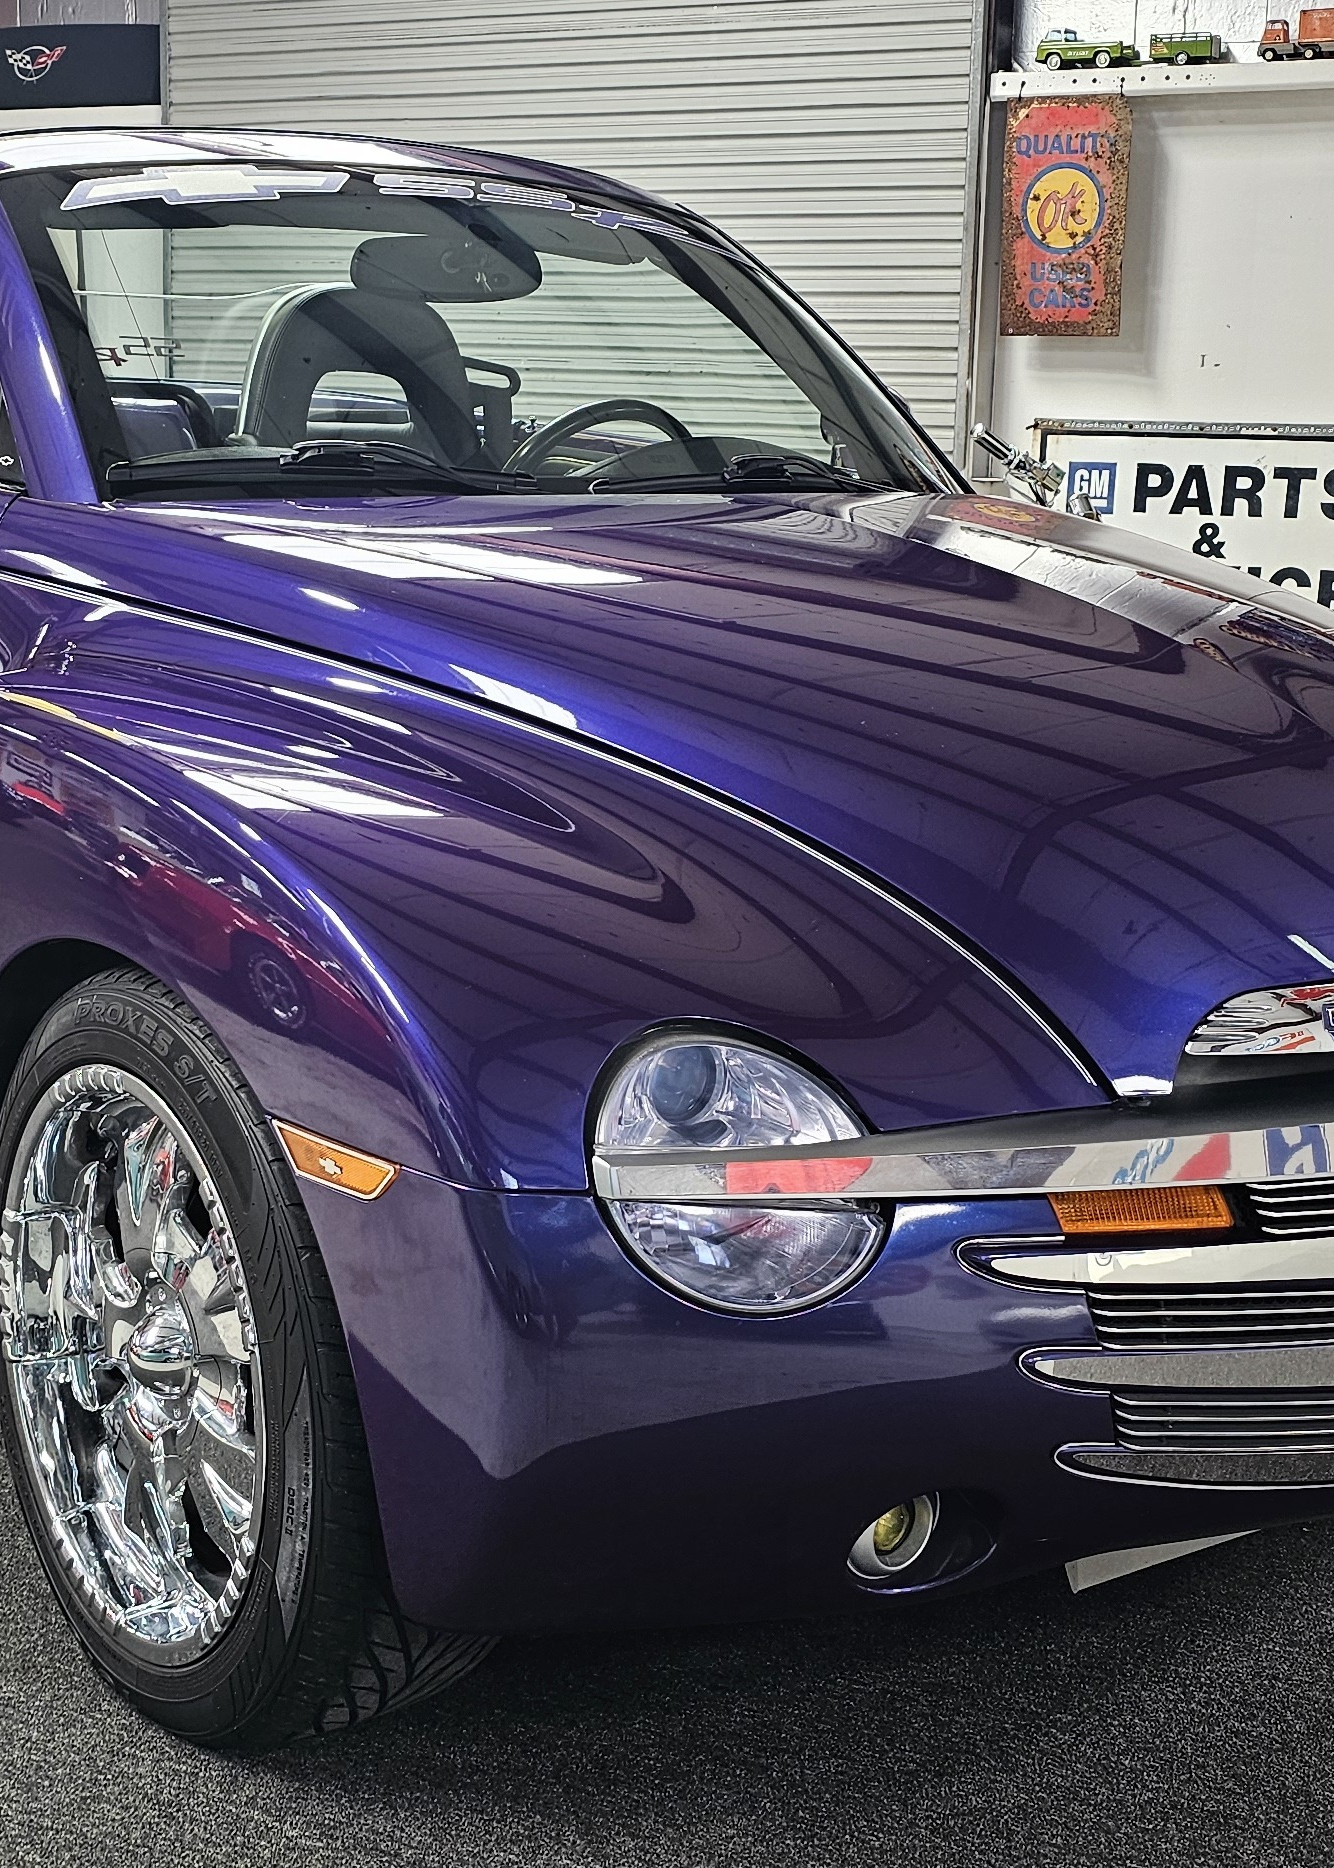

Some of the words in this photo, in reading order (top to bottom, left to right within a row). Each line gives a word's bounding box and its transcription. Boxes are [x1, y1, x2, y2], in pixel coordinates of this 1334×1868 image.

[1036, 180, 1088, 234] OK
[1030, 262, 1092, 284] USED
[1028, 288, 1094, 310] CARS
[1073, 467, 1111, 499] GM
[1192, 522, 1227, 559] &
[75, 995, 175, 1057] PROXES
[174, 1054, 218, 1105] S/T
